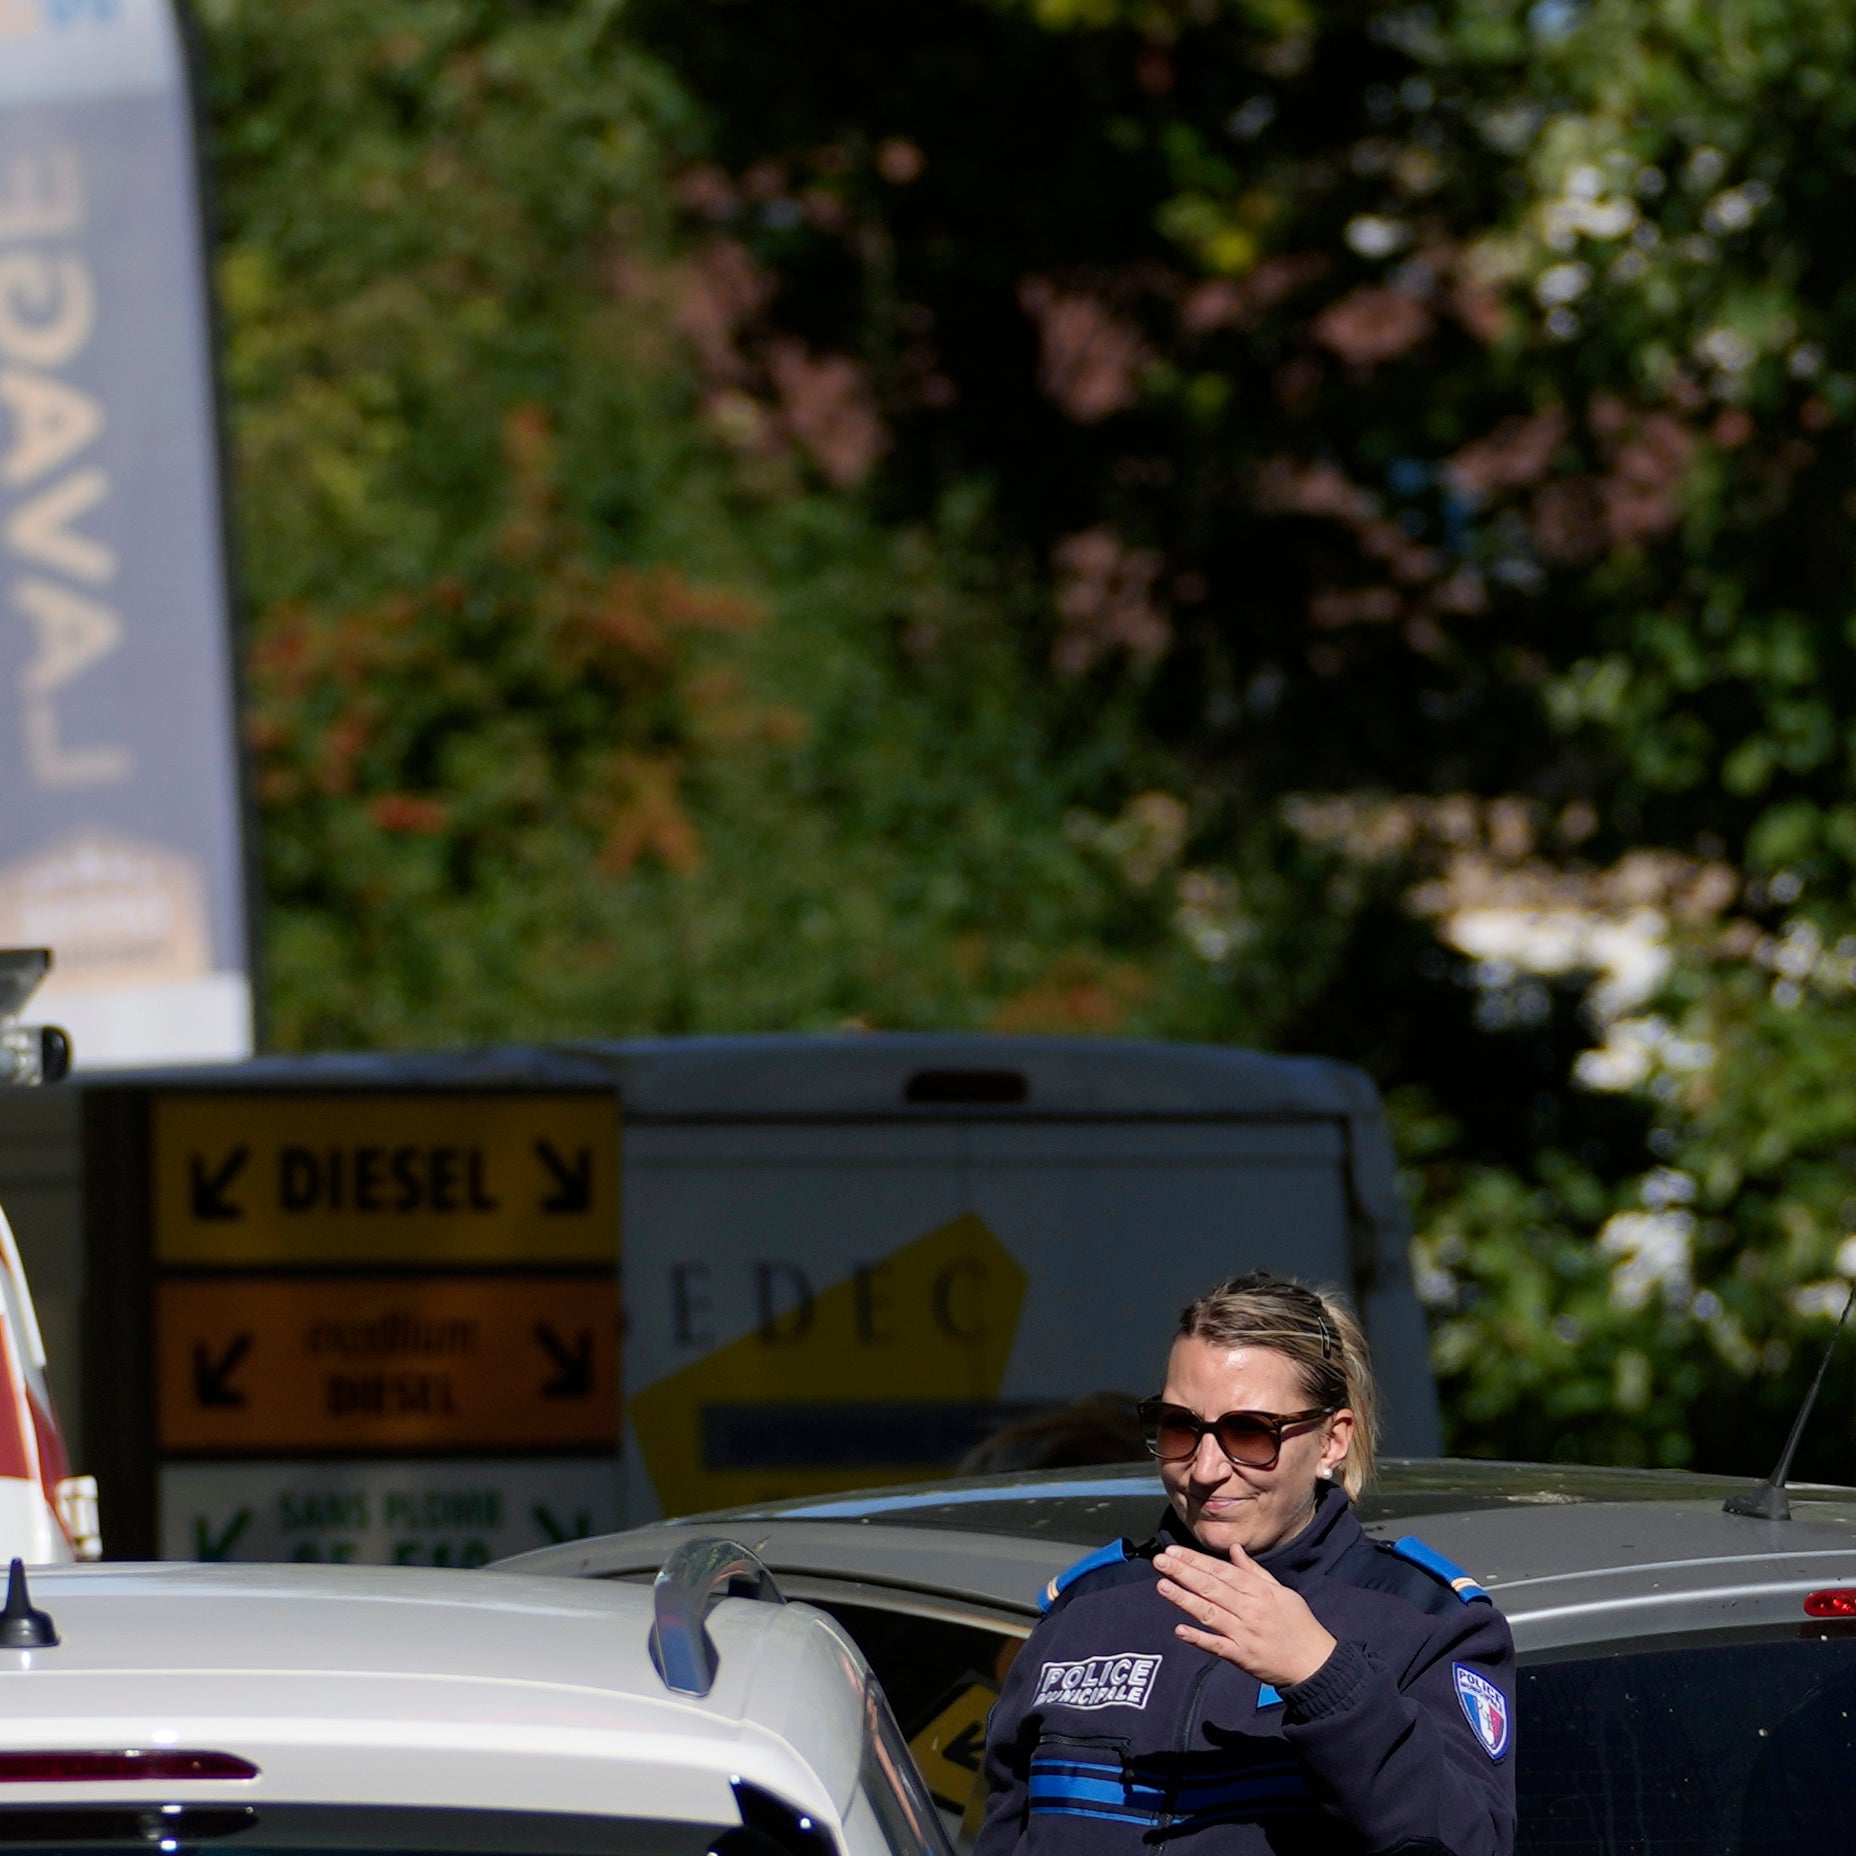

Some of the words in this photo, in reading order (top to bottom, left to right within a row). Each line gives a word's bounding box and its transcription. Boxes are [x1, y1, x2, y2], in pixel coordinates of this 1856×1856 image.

[280, 1144, 496, 1214] DIESEL
[620, 1257, 992, 1348] EDEC
[1041, 1658, 1154, 1692] POLICE
[1458, 1670, 1502, 1702] POLICE
[1032, 1685, 1145, 1707] MUNICIPALE
